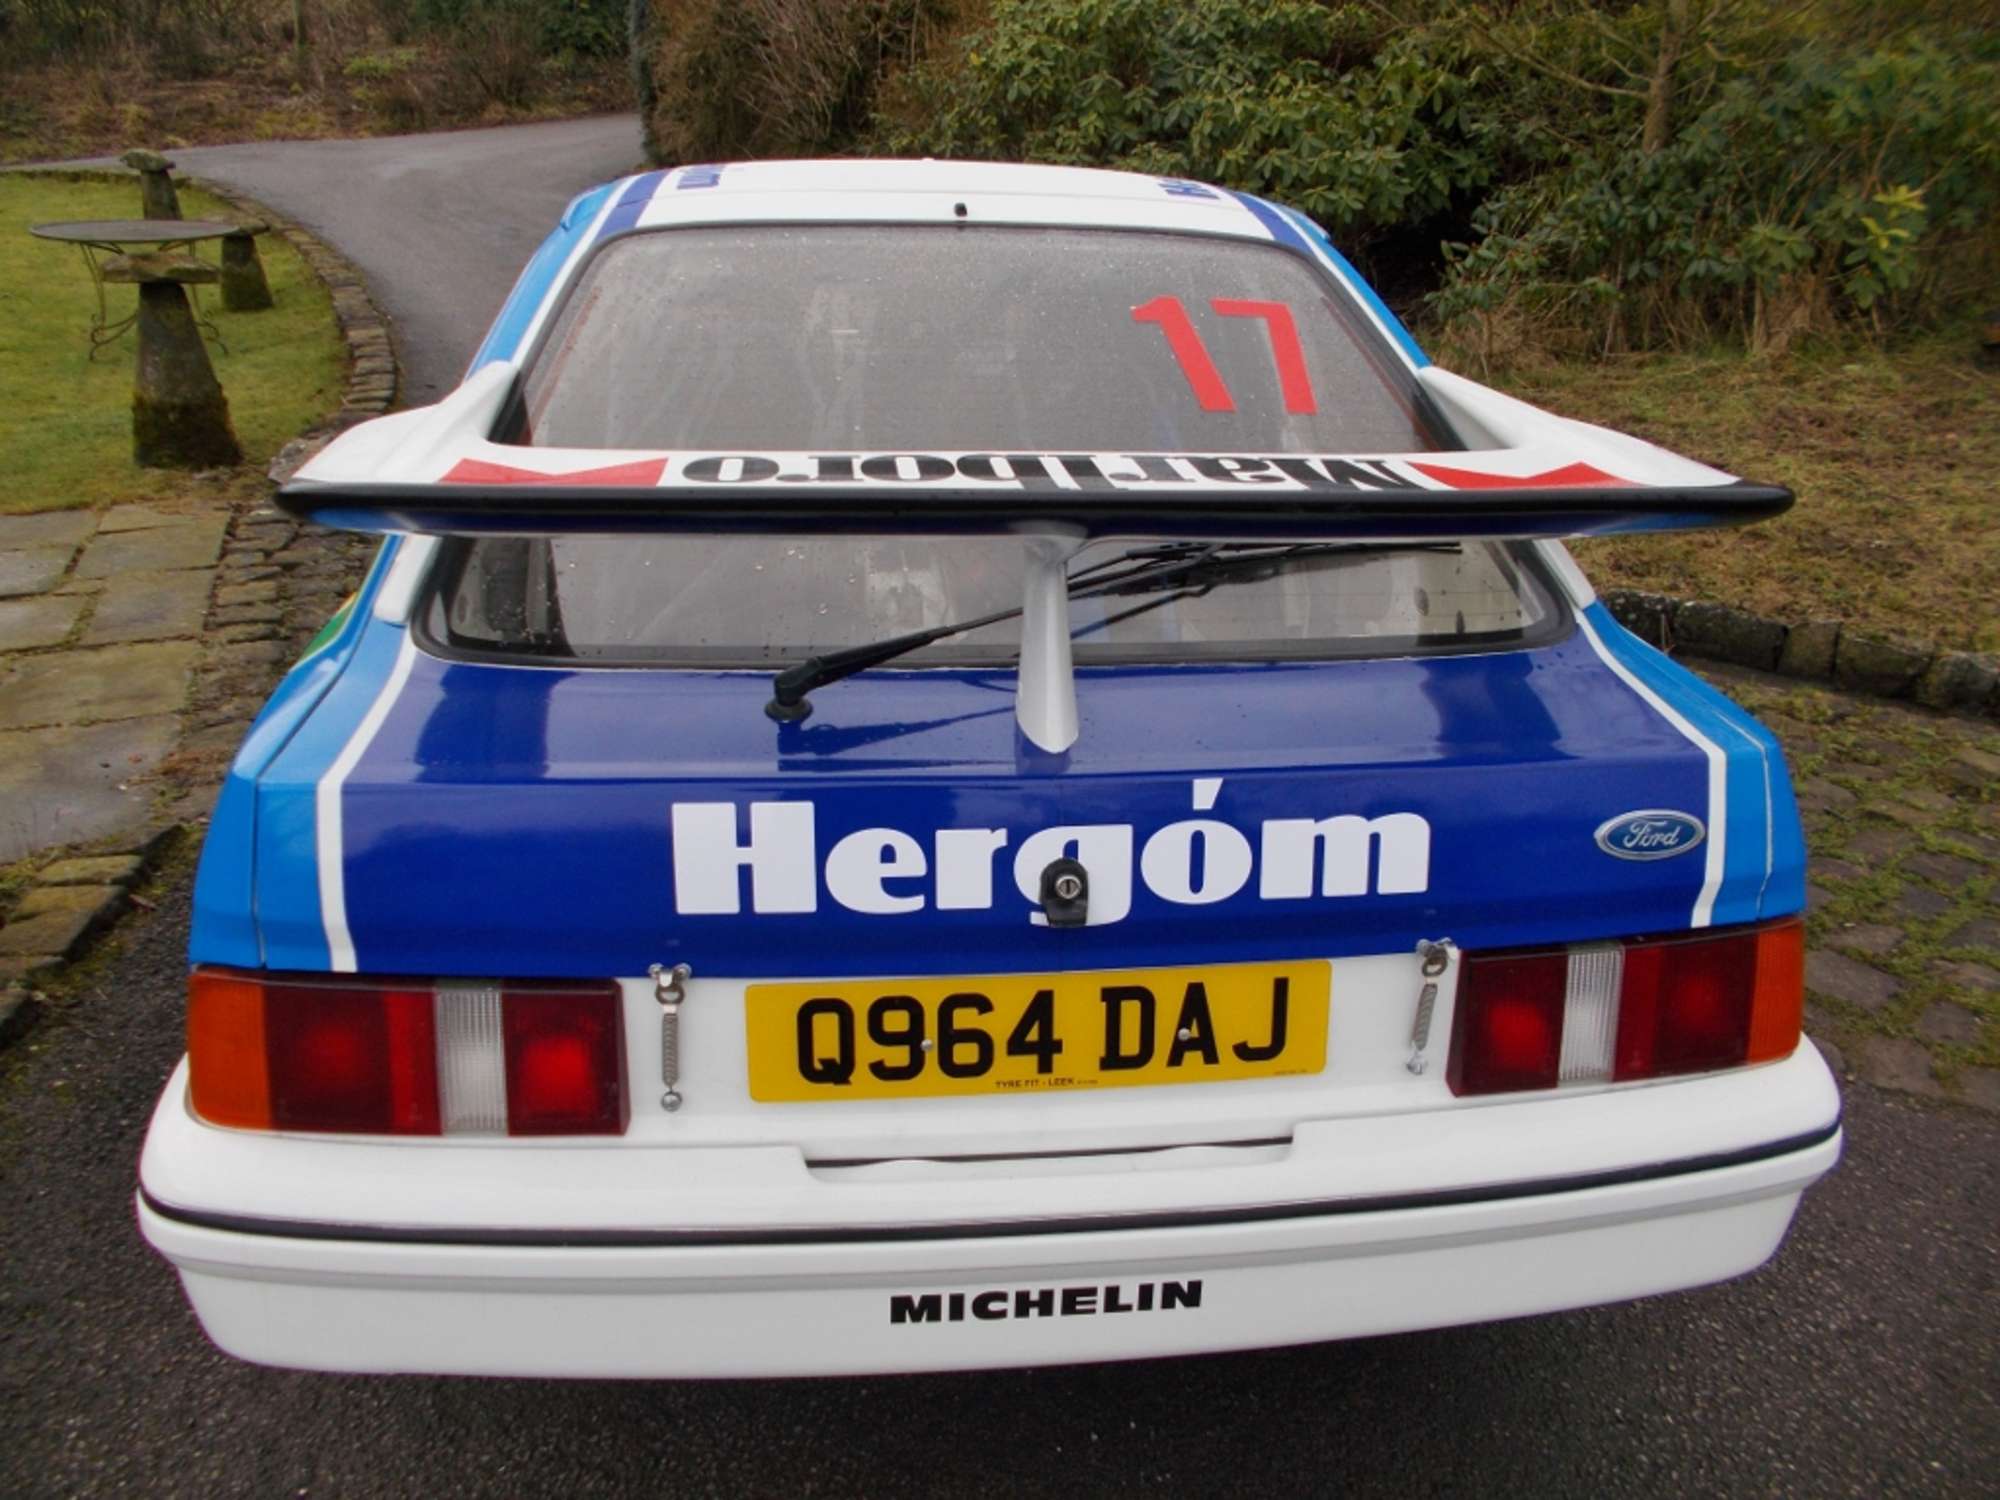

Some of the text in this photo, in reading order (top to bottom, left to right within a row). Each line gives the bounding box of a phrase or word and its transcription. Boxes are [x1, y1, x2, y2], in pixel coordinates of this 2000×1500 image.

[1131, 295, 1317, 414] 17
[682, 453, 1431, 490] Marlboro
[672, 777, 1431, 927] Hergóm
[1622, 820, 1681, 849] Ford
[796, 976, 1290, 1086] Q964 DAJ
[890, 1279, 1203, 1325] MICHELIN
